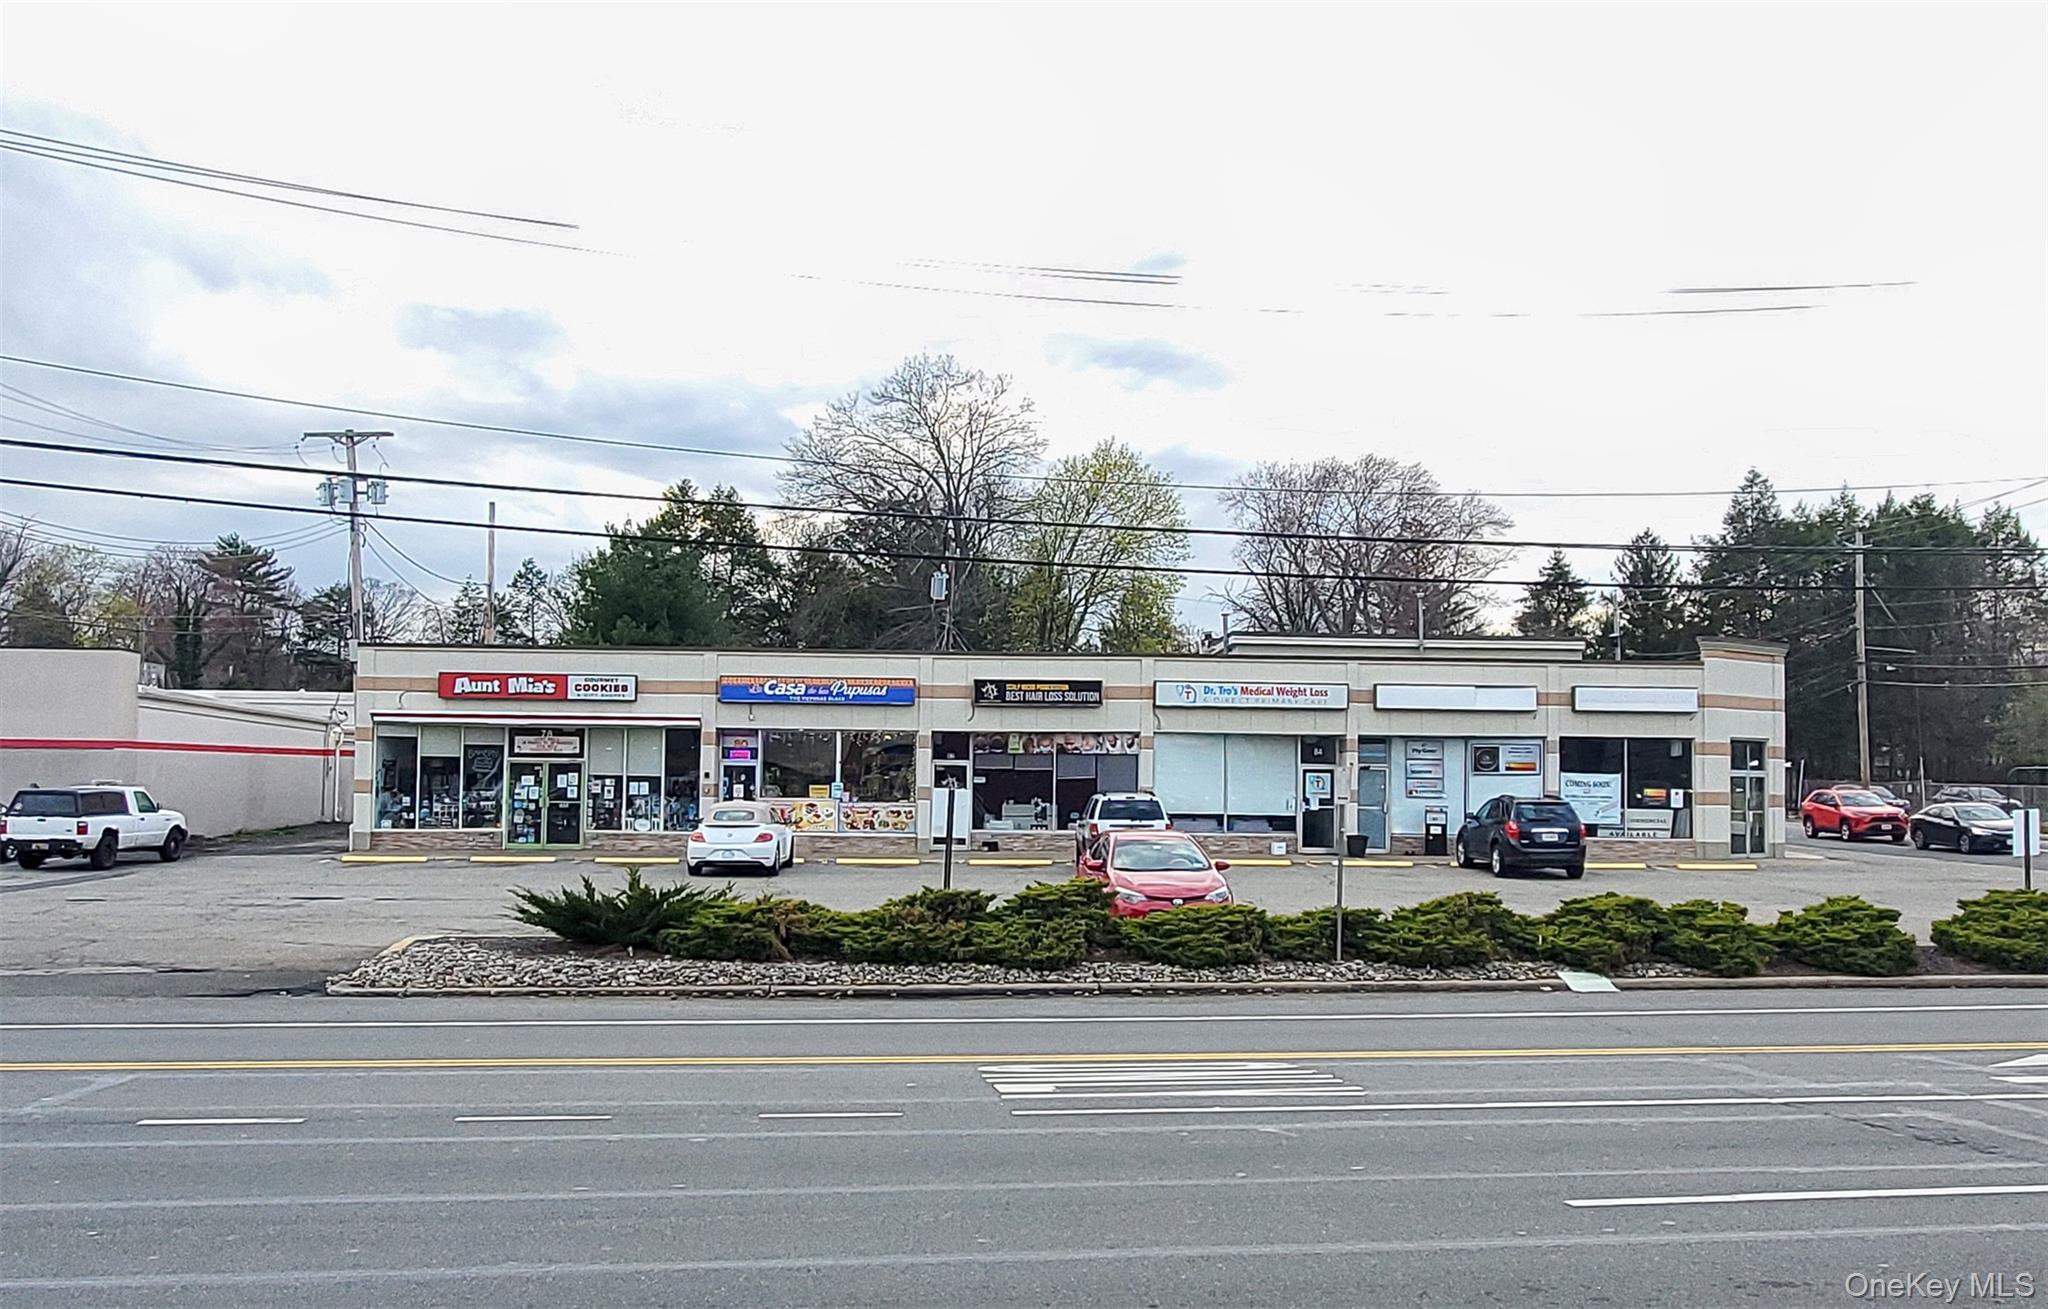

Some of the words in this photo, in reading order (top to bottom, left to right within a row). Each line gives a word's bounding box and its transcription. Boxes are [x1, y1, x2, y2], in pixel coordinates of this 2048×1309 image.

[453, 676, 501, 694] Aunt
[508, 676, 556, 694] Mia's
[574, 684, 629, 692] COOKIES
[763, 680, 806, 696] Casa
[830, 679, 888, 699] Pupusas
[1005, 691, 1024, 701] BEST
[1025, 691, 1043, 701] HAIR
[1044, 691, 1063, 702] LOSS
[1064, 691, 1100, 702] SOLUTION
[1203, 686, 1216, 696] Dr.
[1218, 686, 1238, 696] Tro's
[1240, 686, 1274, 696] Medical
[1276, 687, 1307, 698] Weight
[1309, 687, 1328, 697] Loss
